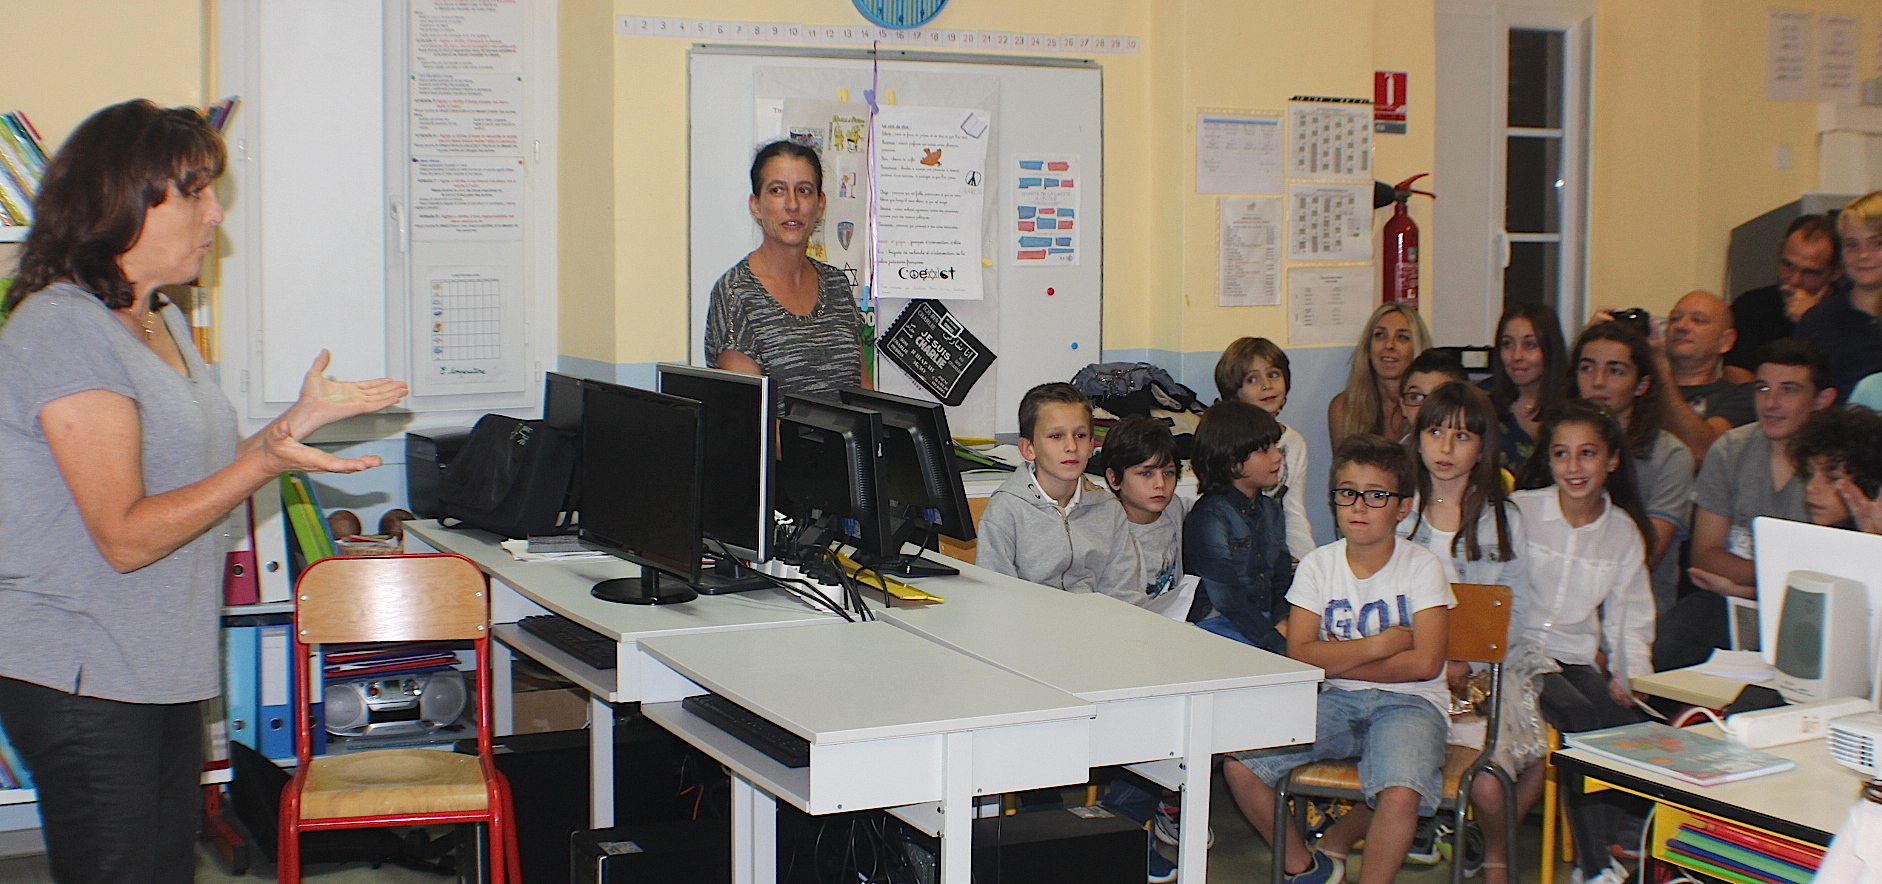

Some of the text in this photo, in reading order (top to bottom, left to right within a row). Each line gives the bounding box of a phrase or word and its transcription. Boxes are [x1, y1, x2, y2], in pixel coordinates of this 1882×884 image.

[624, 19, 628, 28] 1
[641, 20, 647, 29] 2
[660, 21, 666, 30] 3
[679, 22, 684, 30] 4
[697, 22, 704, 32] 5
[717, 24, 724, 34] 6
[754, 26, 760, 35] 8
[772, 26, 778, 36] 9
[789, 26, 798, 36] 10
[808, 30, 816, 38] 11
[825, 30, 835, 39] 12
[843, 29, 852, 38] 13
[861, 30, 869, 38] 14
[878, 30, 887, 38] 15
[895, 31, 904, 40] 16
[913, 32, 922, 40] 17
[930, 32, 939, 41] 18
[947, 33, 956, 42] 19
[982, 35, 991, 43] 21
[998, 35, 1008, 44] 22
[1014, 36, 1024, 45] 23
[1031, 36, 1040, 46] 24
[1047, 36, 1057, 47] 25
[1064, 36, 1074, 46] 26
[1079, 36, 1089, 46] 27
[1095, 38, 1105, 48] 28
[1110, 40, 1121, 48] 29
[1126, 39, 1136, 48] 30
[913, 334, 947, 369] CHARLIE
[919, 329, 933, 342] JE
[930, 339, 952, 361] SUIS
